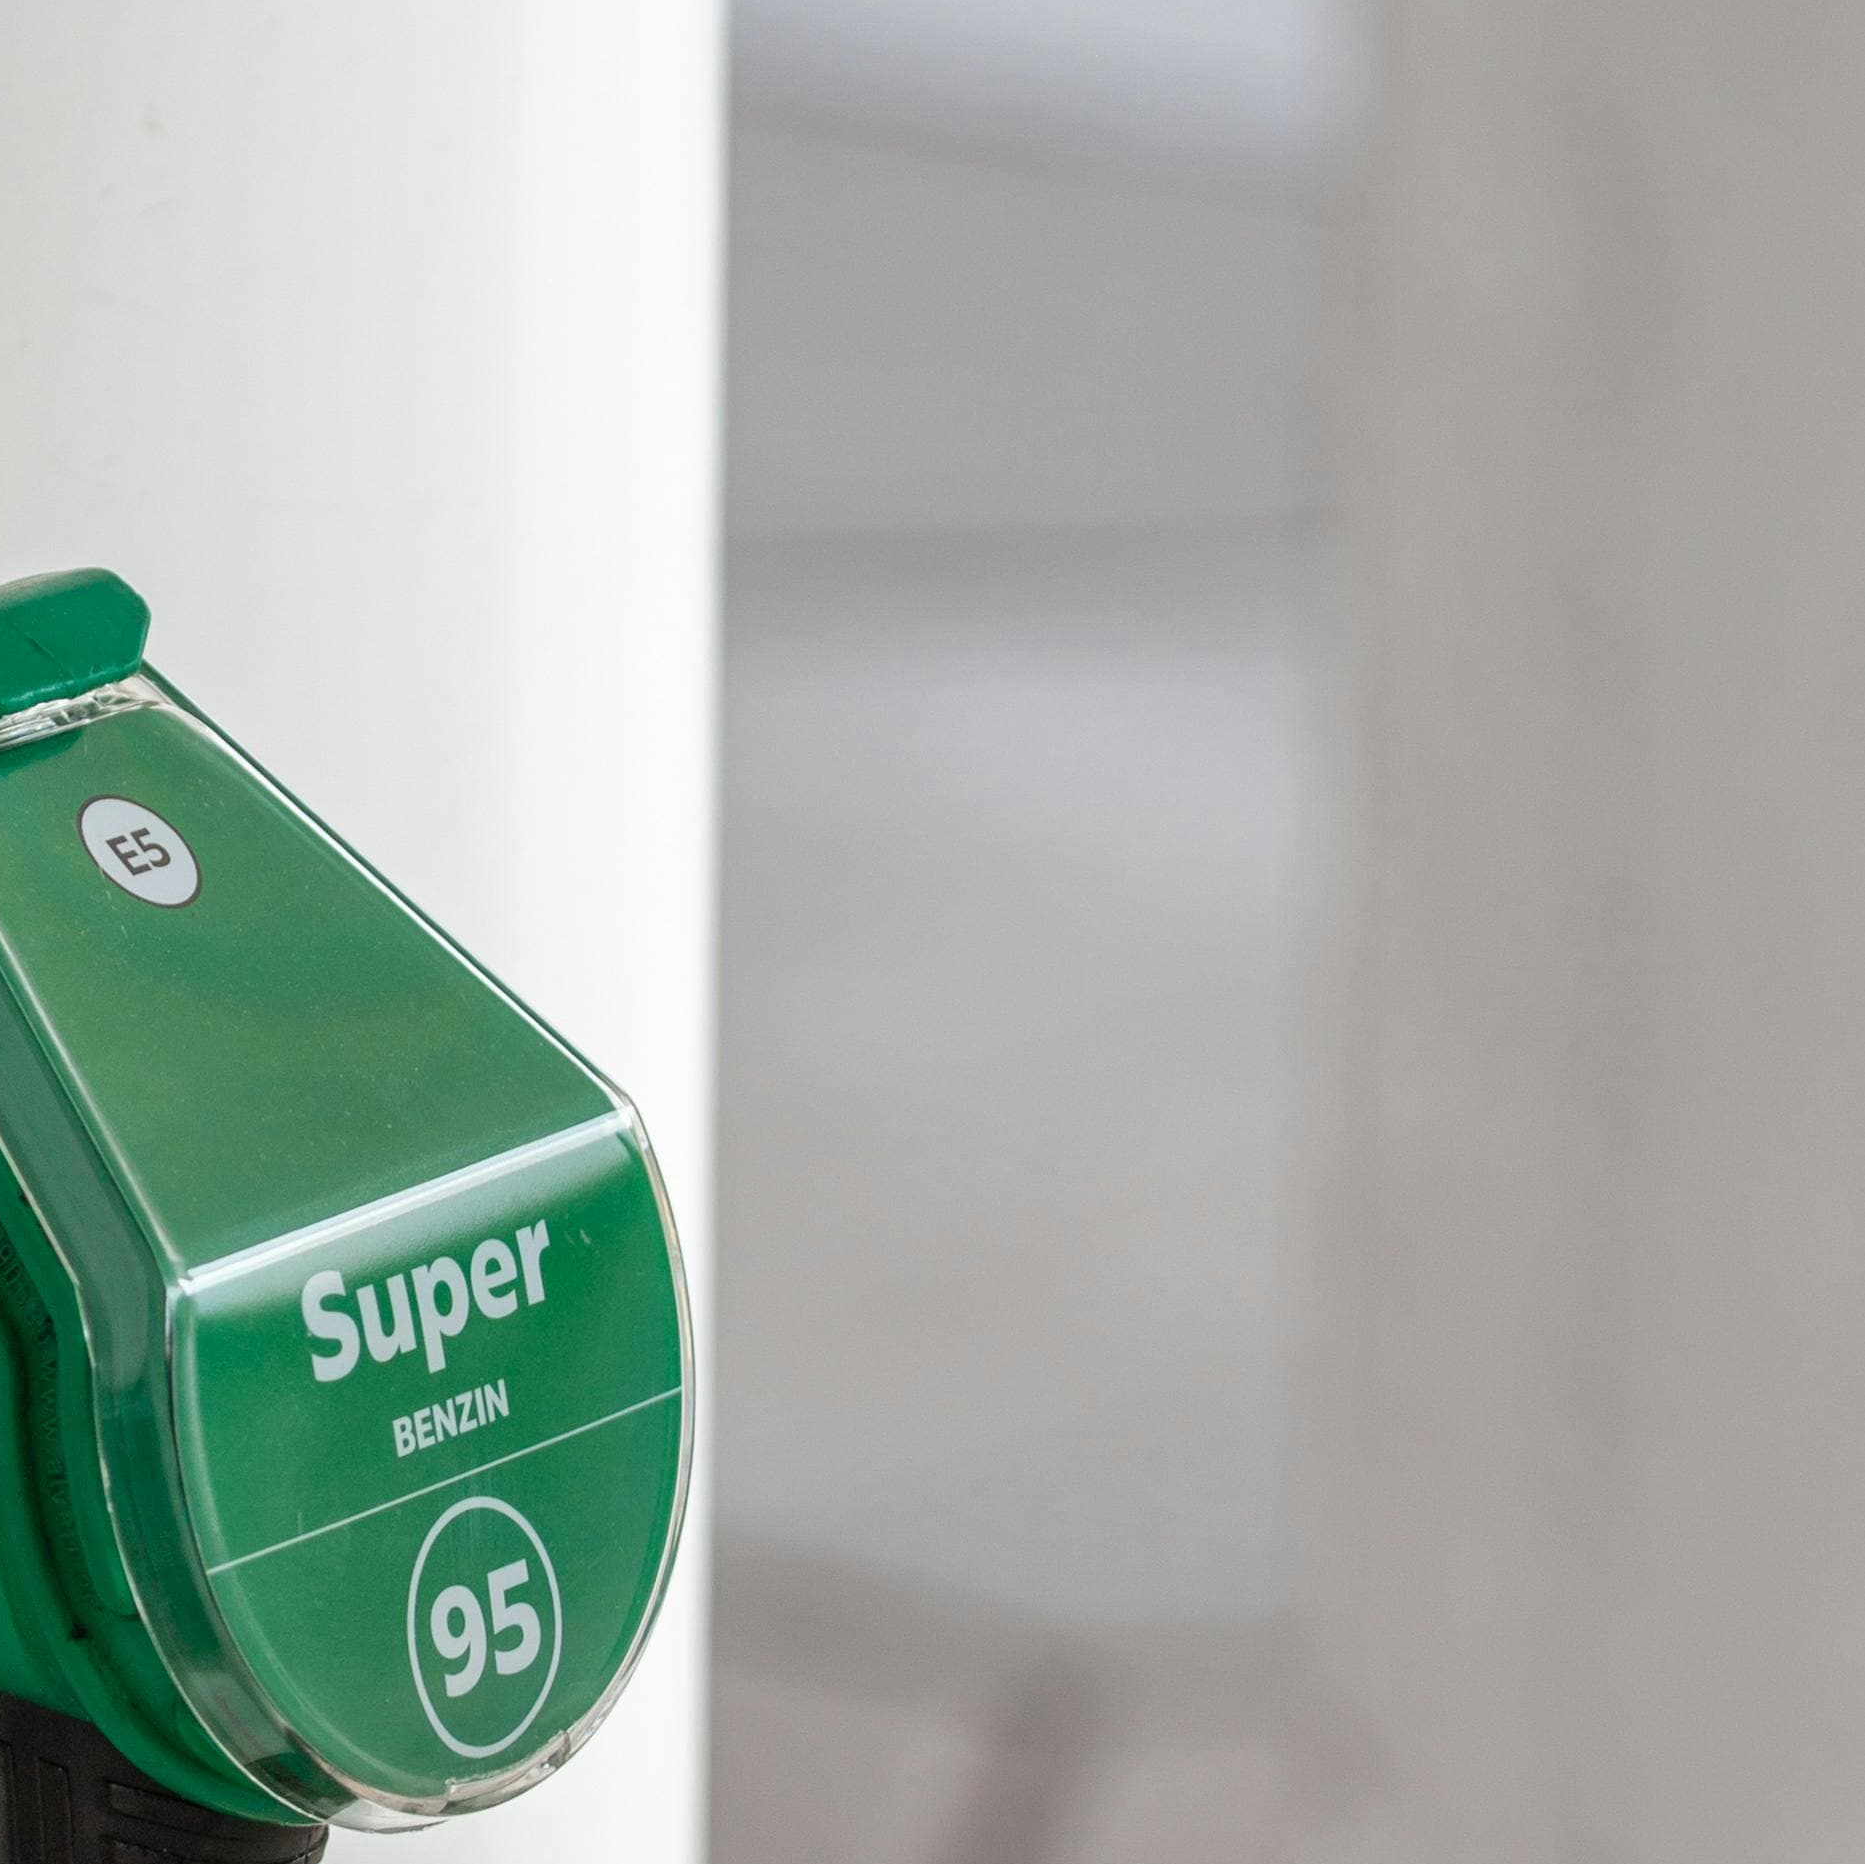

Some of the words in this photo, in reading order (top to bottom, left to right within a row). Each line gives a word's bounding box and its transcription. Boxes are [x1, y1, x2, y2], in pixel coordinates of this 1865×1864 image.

[105, 827, 171, 876] E5
[300, 1219, 551, 1383] Super
[392, 1379, 510, 1458] BENZIN
[430, 1558, 542, 1698] 95
